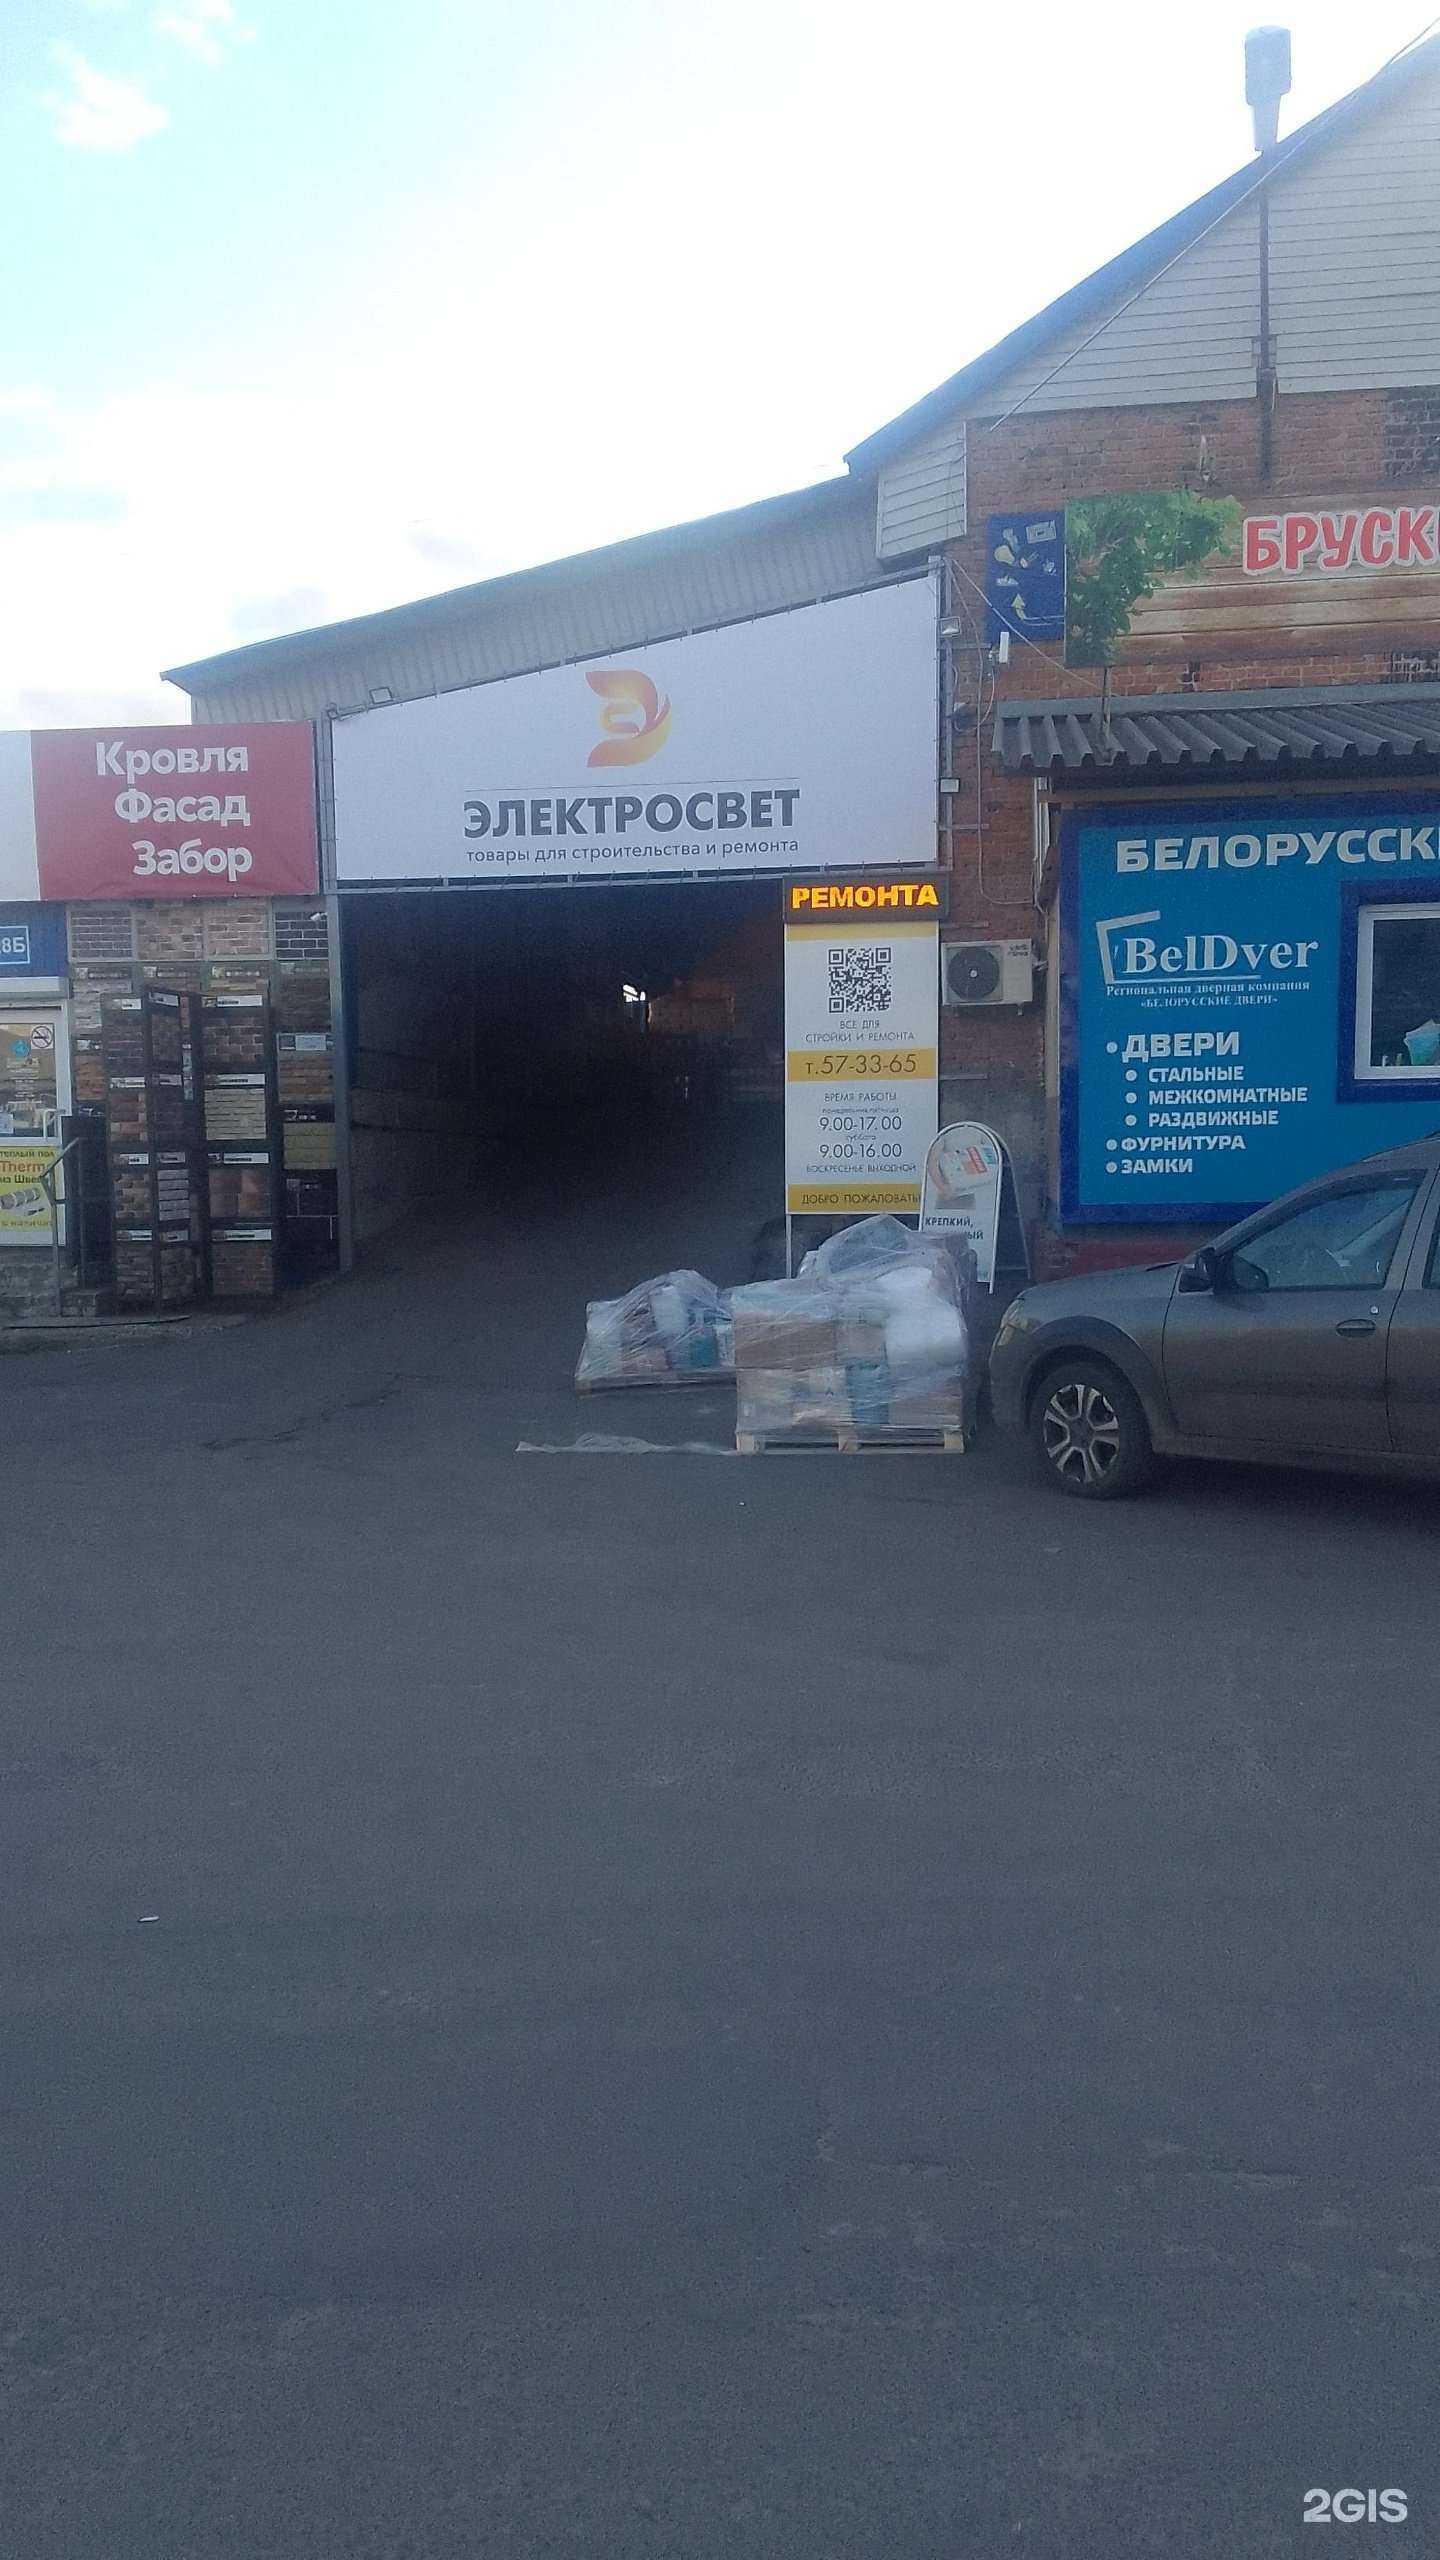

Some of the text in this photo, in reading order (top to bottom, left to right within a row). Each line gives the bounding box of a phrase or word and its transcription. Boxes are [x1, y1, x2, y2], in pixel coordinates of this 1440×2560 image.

[1243, 506, 1440, 574] БРУСК
[96, 741, 248, 783] Кровля
[114, 788, 251, 827] Фасад
[464, 788, 800, 838] ЭЛЕКТРОСВЕТ
[466, 838, 798, 864] товары для строительства и ремонта
[1116, 827, 1440, 873] БЕЛОРУССК
[132, 839, 253, 881] Забор
[791, 884, 939, 909] РЕМОНТА
[0, 936, 25, 953] 8Б
[1123, 935, 1319, 973] BelDver
[1106, 981, 1310, 996] Региональная дверная компания
[840, 1019, 880, 1029] ВСЕ ДЛЯ
[806, 1031, 915, 1043] СТРОЙКИ И РЕМОНТА
[1122, 1031, 1240, 1063] ДВЕРИ
[1148, 1066, 1244, 1081] СТАЛЬНЫЕ
[824, 1092, 897, 1102] ВРЕМЯ РАБОТЫ
[1148, 1087, 1308, 1104] МЕЖКОМНАТНЫЕ
[1148, 1110, 1279, 1129] РАЗДВИЖНЫЕ
[1122, 1135, 1246, 1152] ФУРНИТУРА
[1122, 1158, 1194, 1174] ЗАМКИ
[802, 1194, 839, 1204] ДОБРО
[924, 1216, 974, 1227] КРЕПКИЙ,
